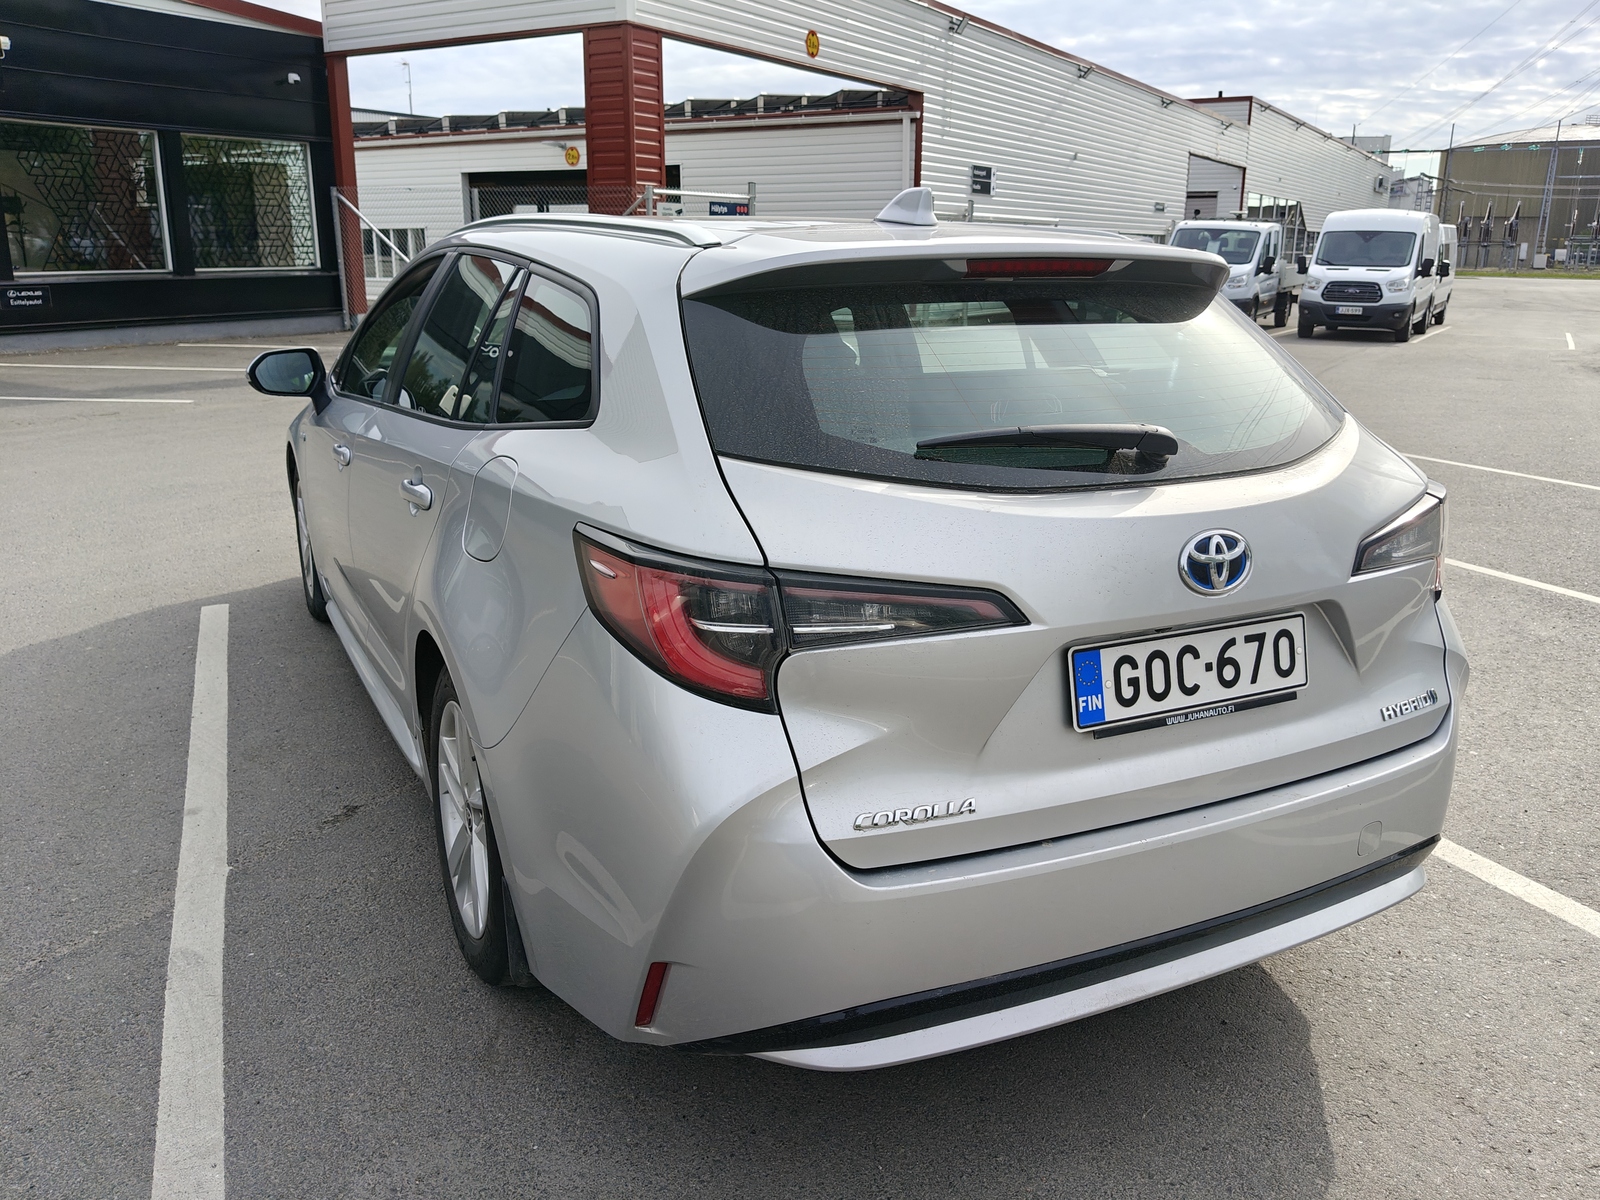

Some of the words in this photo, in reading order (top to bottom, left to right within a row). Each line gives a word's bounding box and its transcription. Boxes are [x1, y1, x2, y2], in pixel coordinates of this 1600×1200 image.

[1113, 628, 1296, 708] GOC-670
[1078, 693, 1102, 713] FIN
[1166, 705, 1235, 725] WWW.JUHANAUTO.FI
[1380, 692, 1433, 721] HYBRID
[853, 797, 976, 831] COROLLA
